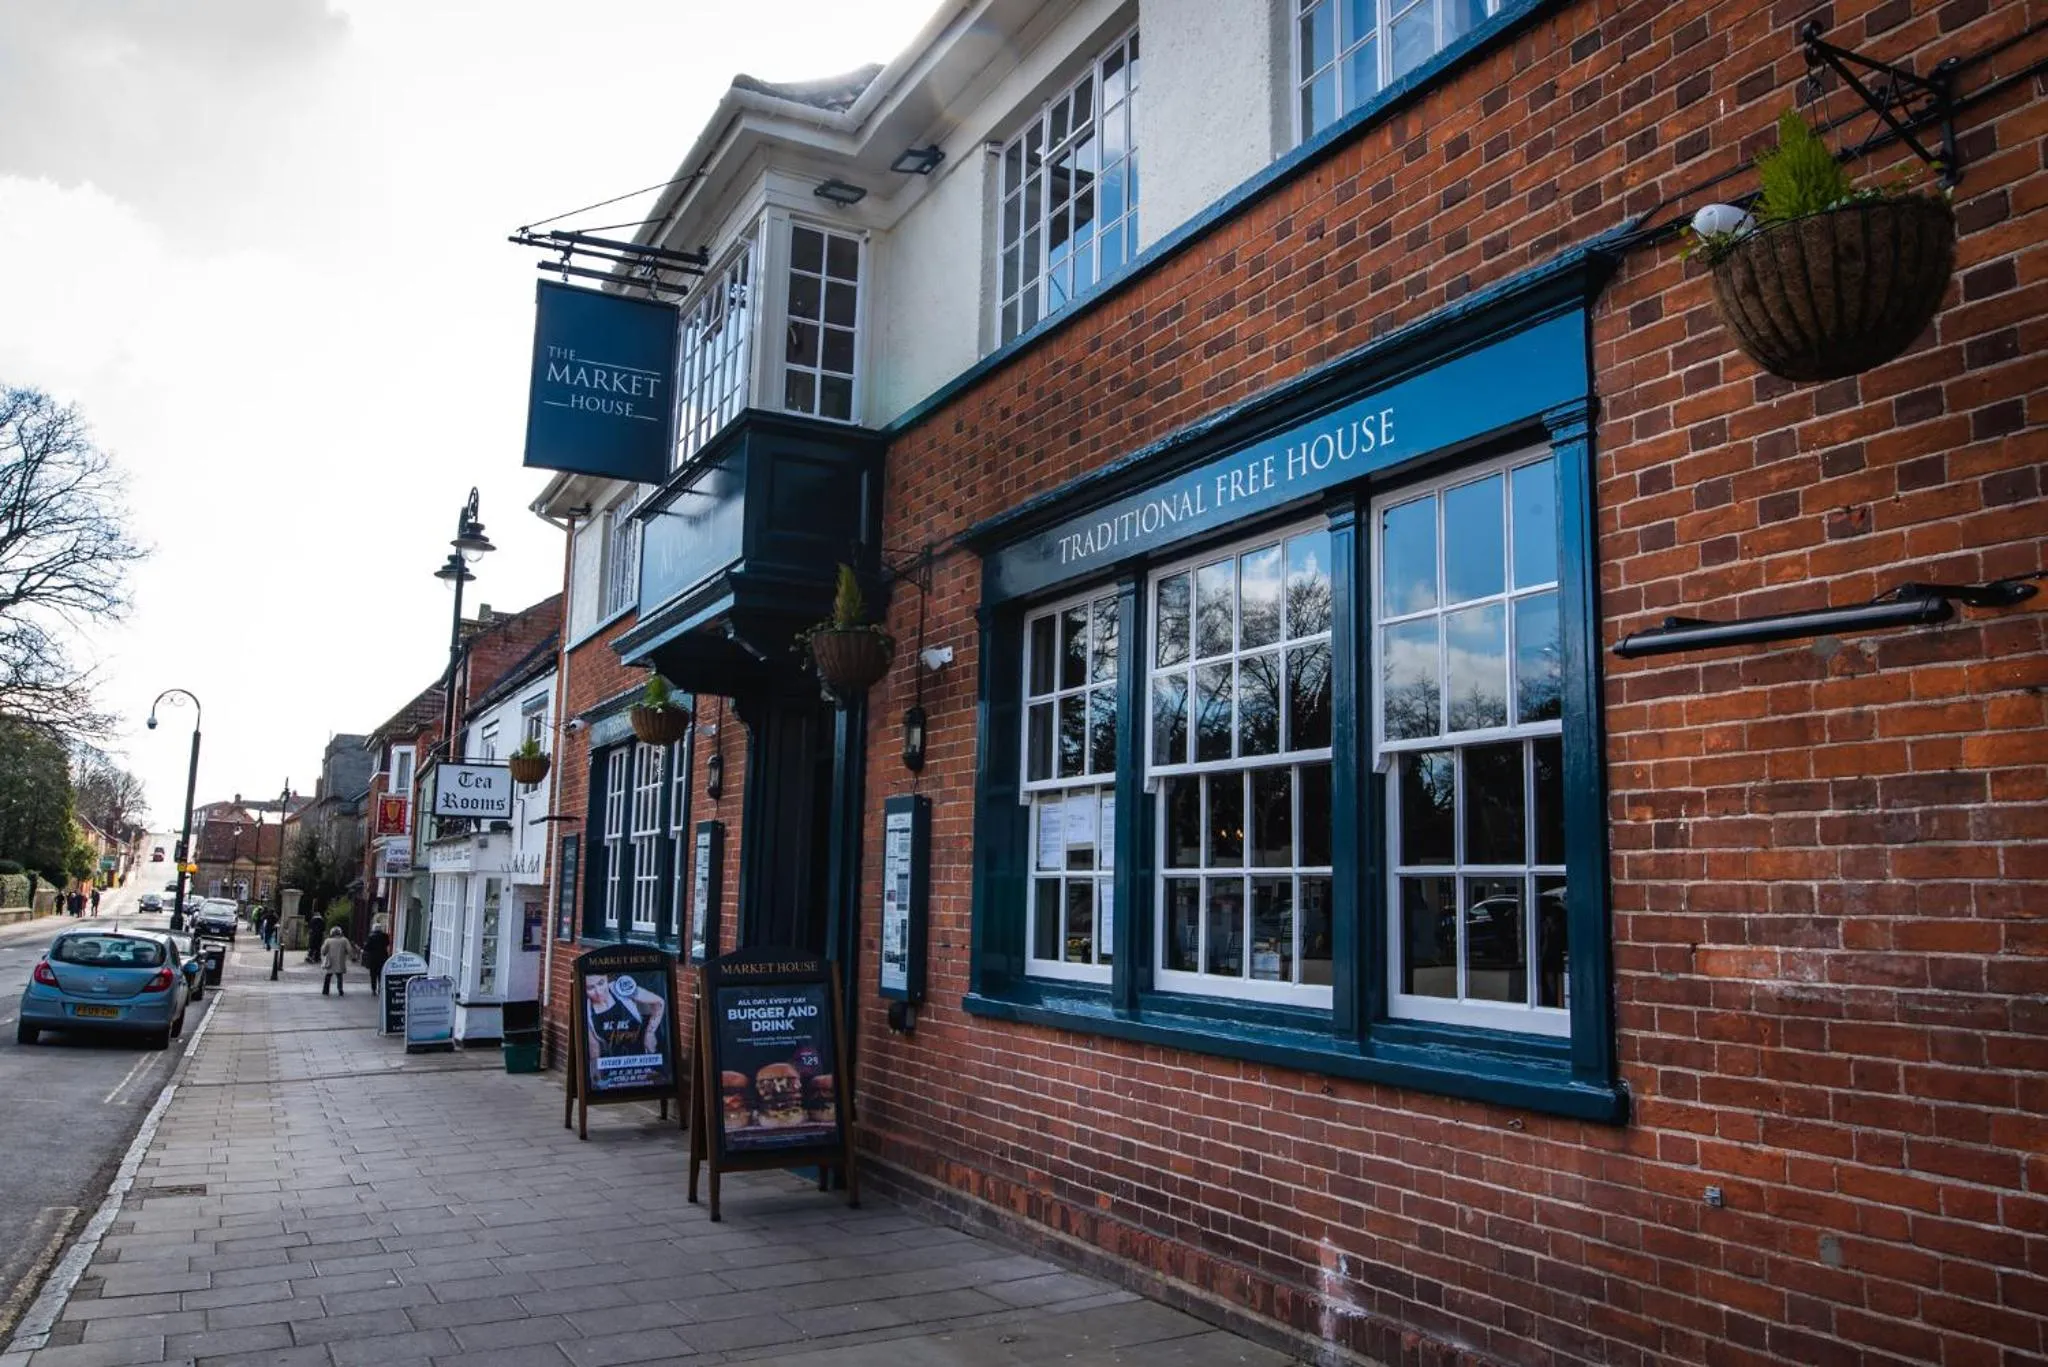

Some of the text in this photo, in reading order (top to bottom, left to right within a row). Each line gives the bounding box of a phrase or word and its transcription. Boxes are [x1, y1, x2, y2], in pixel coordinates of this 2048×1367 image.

[548, 346, 576, 361] THE
[547, 362, 661, 398] MARKET
[571, 394, 634, 417] HOUSE
[1058, 407, 1395, 565] TRADITIONAL FREE HOUSE
[458, 771, 492, 789] Tea
[442, 791, 506, 811] Rooms
[721, 961, 819, 975] MARKET HOUSE
[728, 1005, 818, 1020] BURGER AND
[751, 1019, 796, 1032] DRINK
